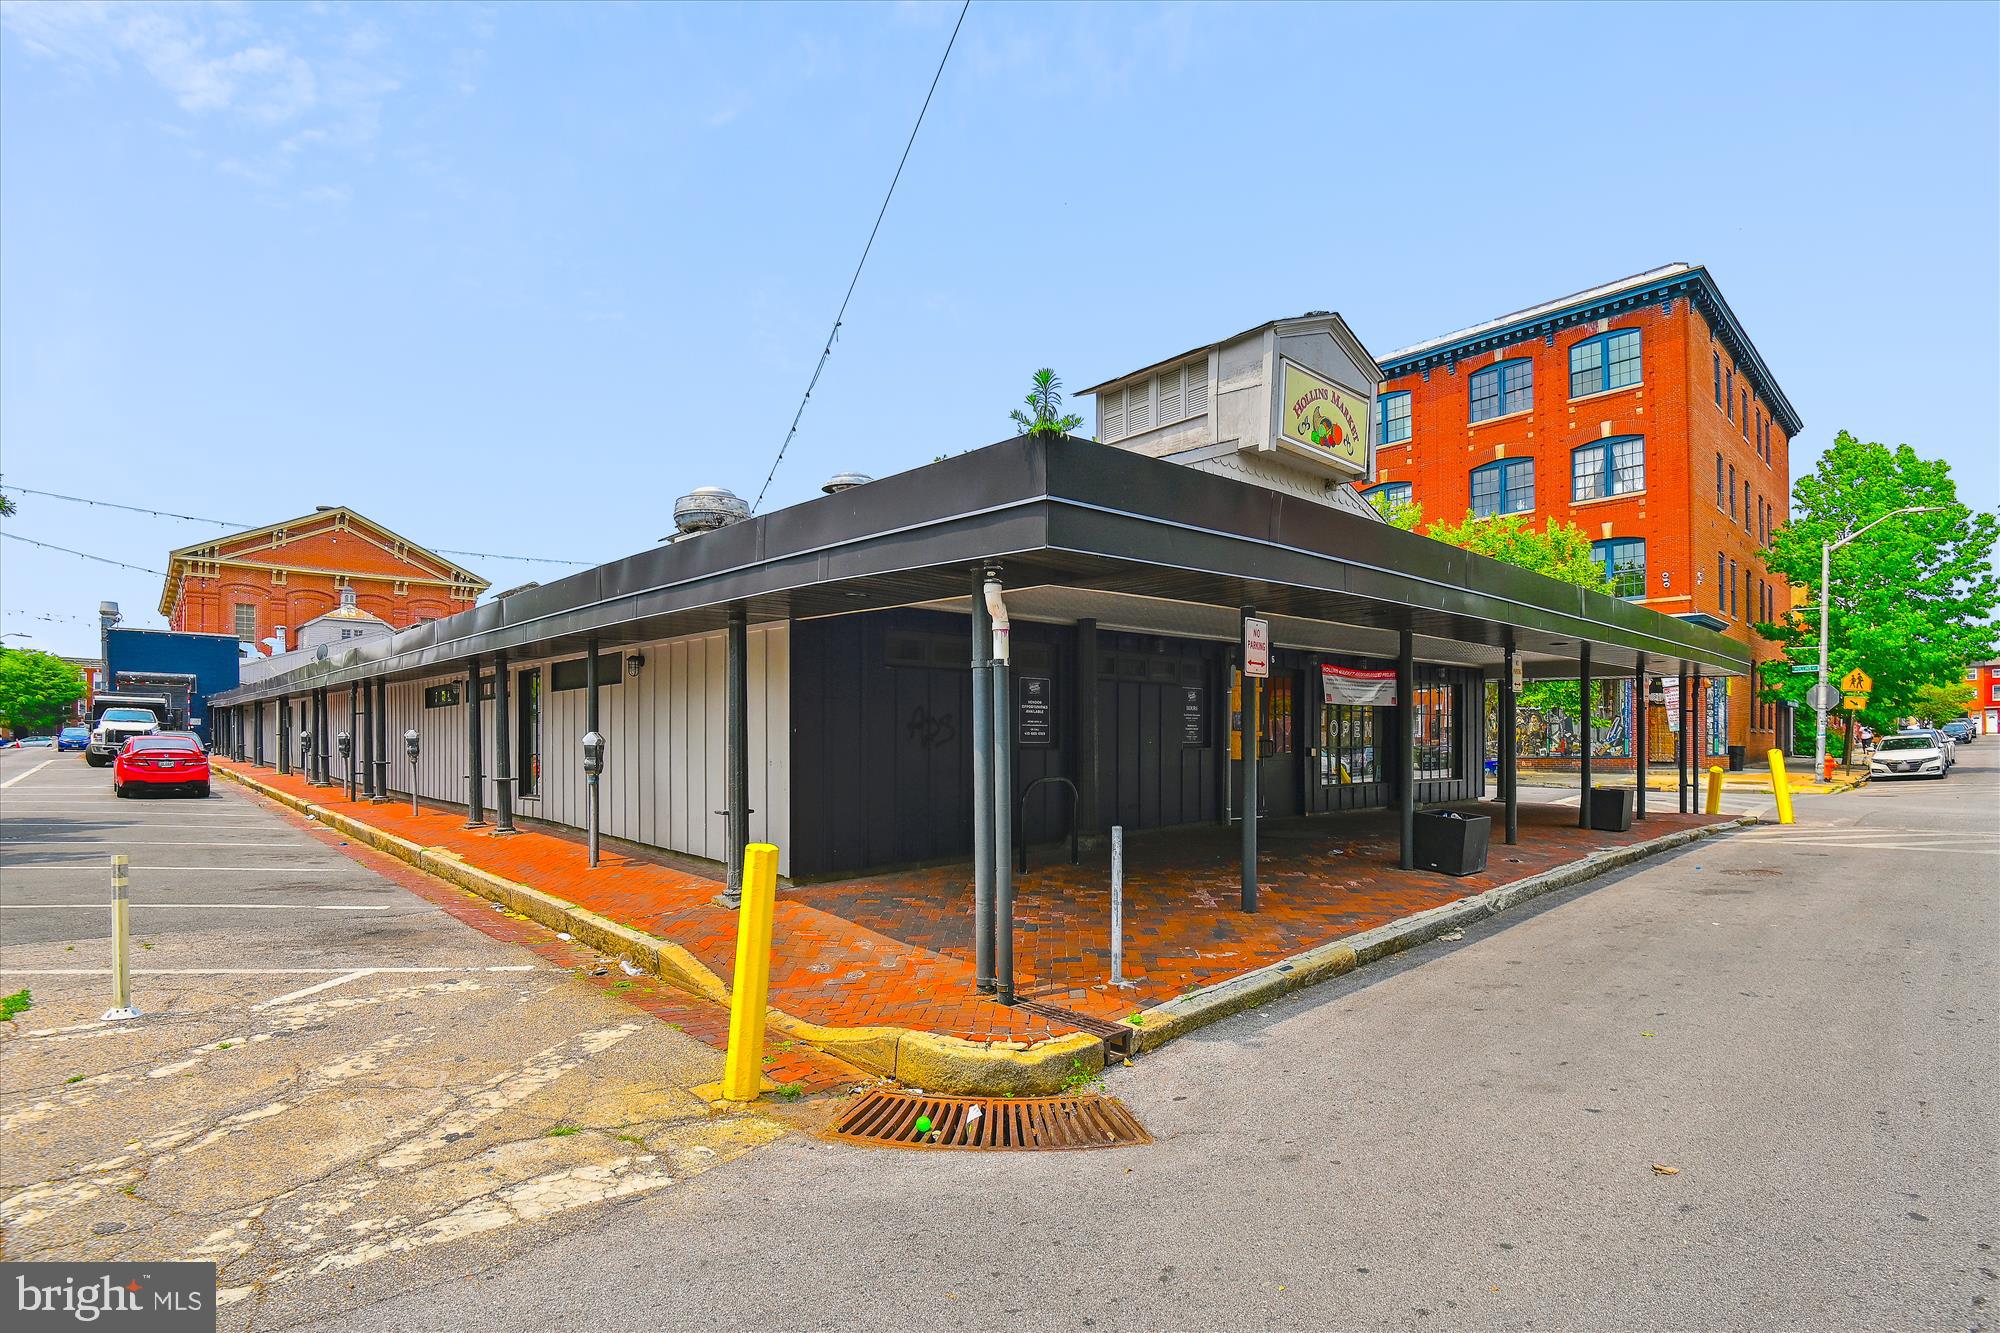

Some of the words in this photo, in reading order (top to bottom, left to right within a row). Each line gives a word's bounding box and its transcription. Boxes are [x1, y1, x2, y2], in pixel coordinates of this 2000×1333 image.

[1252, 629, 1261, 639] NO
[1248, 640, 1266, 651] PARKING
[1330, 720, 1372, 738] OPEN
